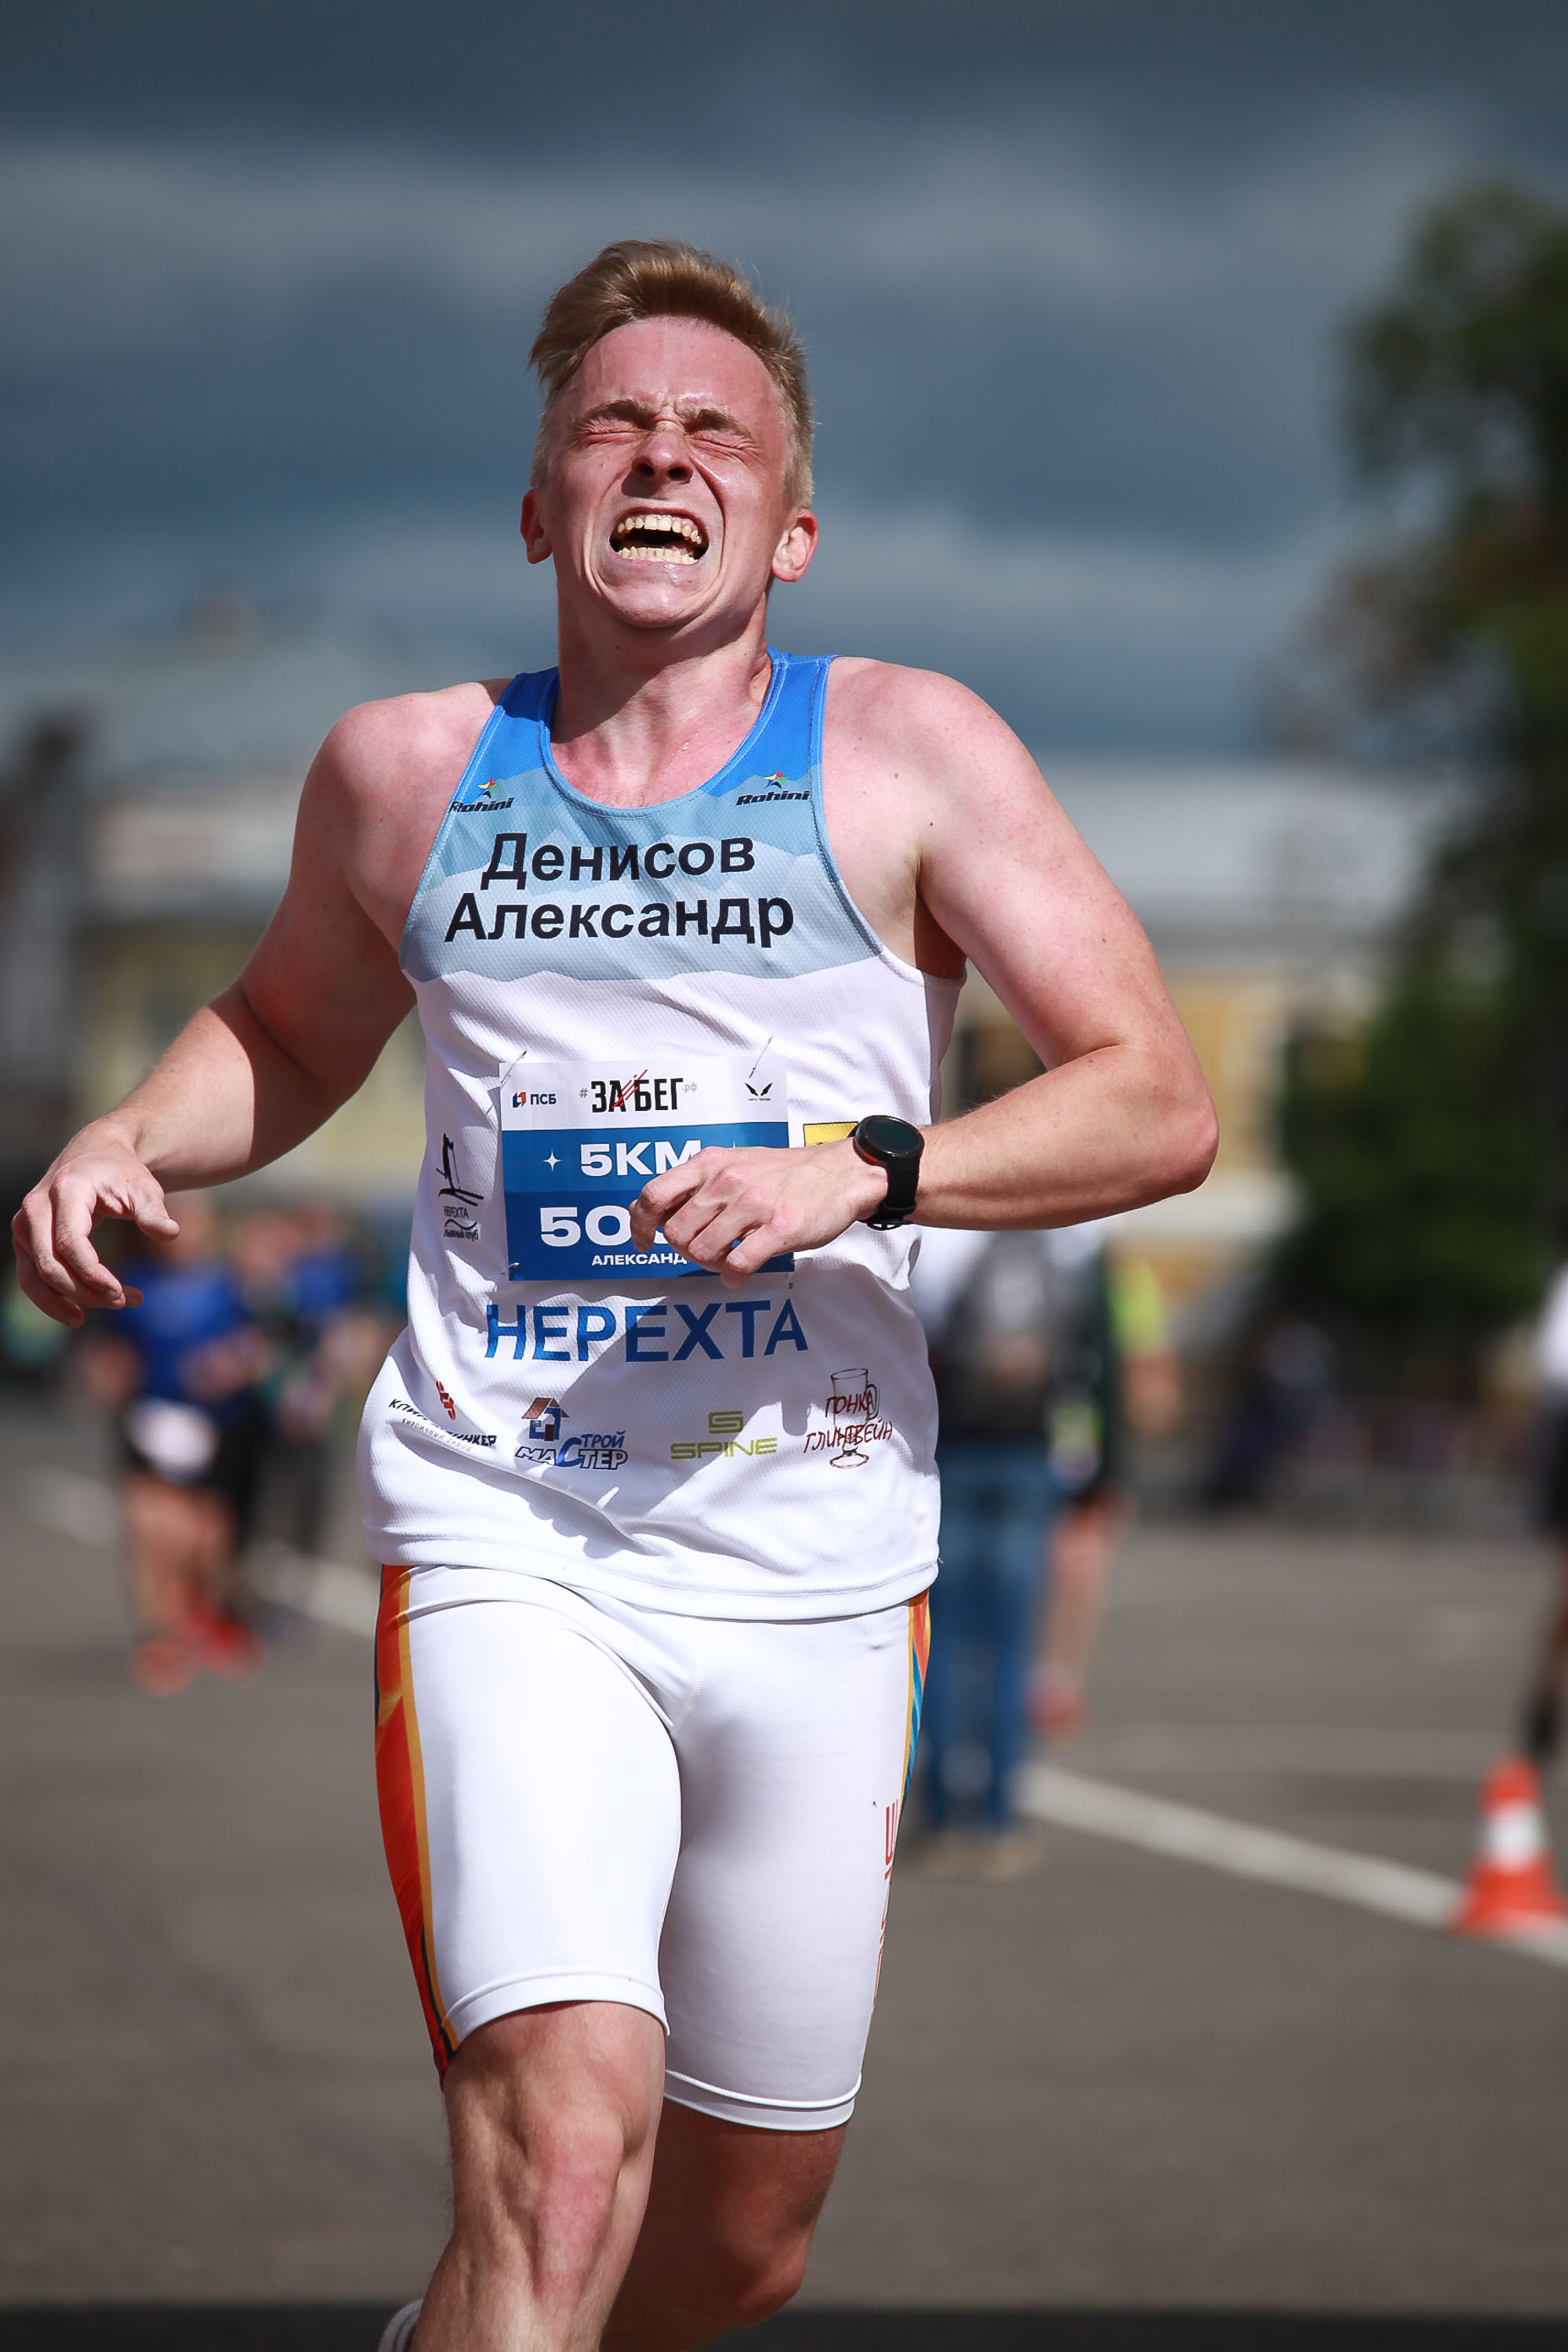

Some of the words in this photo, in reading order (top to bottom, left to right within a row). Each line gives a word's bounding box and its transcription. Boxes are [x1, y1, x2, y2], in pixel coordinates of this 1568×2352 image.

[448, 797, 514, 812] Rohini
[735, 790, 811, 806] Rohini
[481, 833, 756, 891] Денисов
[445, 893, 794, 949] Александр
[530, 1094, 557, 1105] ПСБ
[540, 1205, 669, 1248] 50
[591, 1252, 690, 1266] АЛЕКСАНД
[485, 1298, 809, 1363] НЕРЕХТА
[825, 1389, 874, 1418] ГОНКА
[670, 1437, 778, 1460] SPINE
[803, 1417, 893, 1454] ГЛИНТВЕЙН
